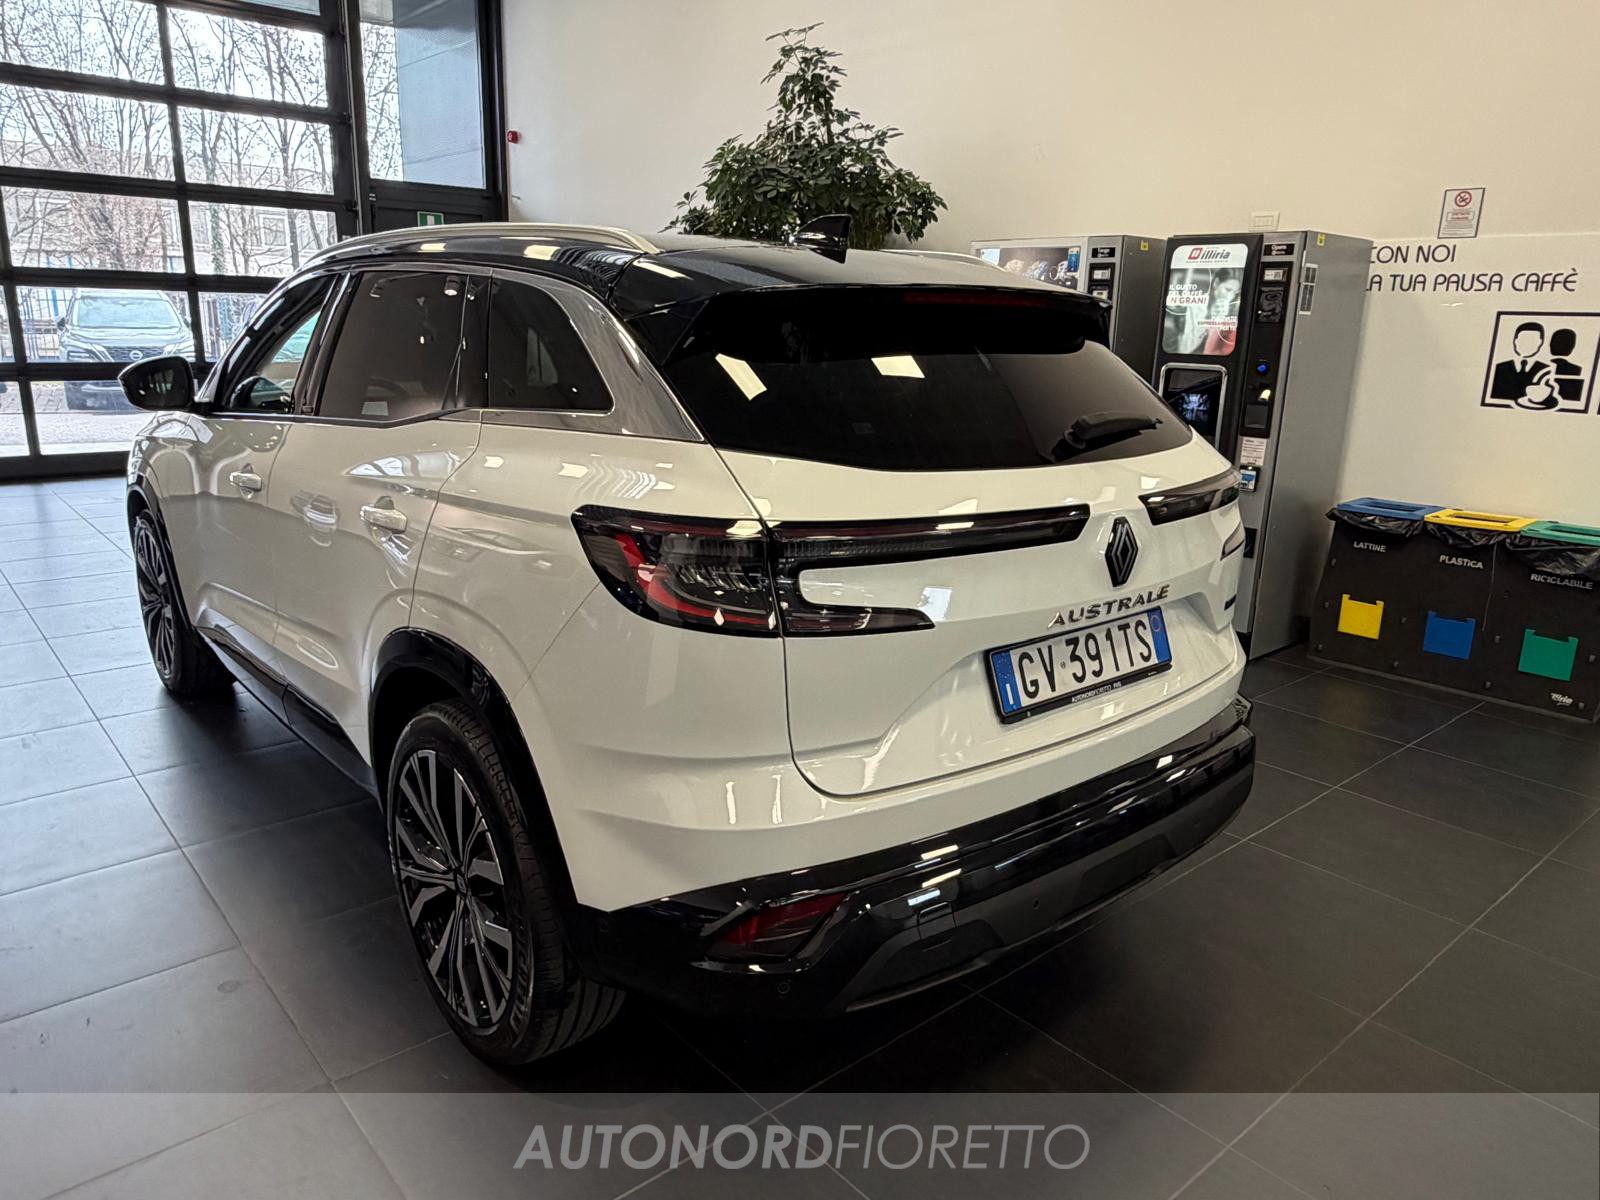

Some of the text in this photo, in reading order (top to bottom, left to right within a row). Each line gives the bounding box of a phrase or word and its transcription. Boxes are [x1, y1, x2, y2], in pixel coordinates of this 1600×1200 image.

[1416, 244, 1457, 263] NOI
[1366, 267, 1578, 292] A TUA PAUSA CAFFÈ
[1179, 297, 1207, 305] GRANI
[1353, 540, 1387, 553] LATTINE
[1439, 554, 1484, 570] PLASTICA
[1530, 573, 1594, 590] RICICLABILE
[1047, 584, 1170, 629] AUSTRALE
[1017, 645, 1057, 699] GV
[1064, 618, 1153, 684] 391TS
